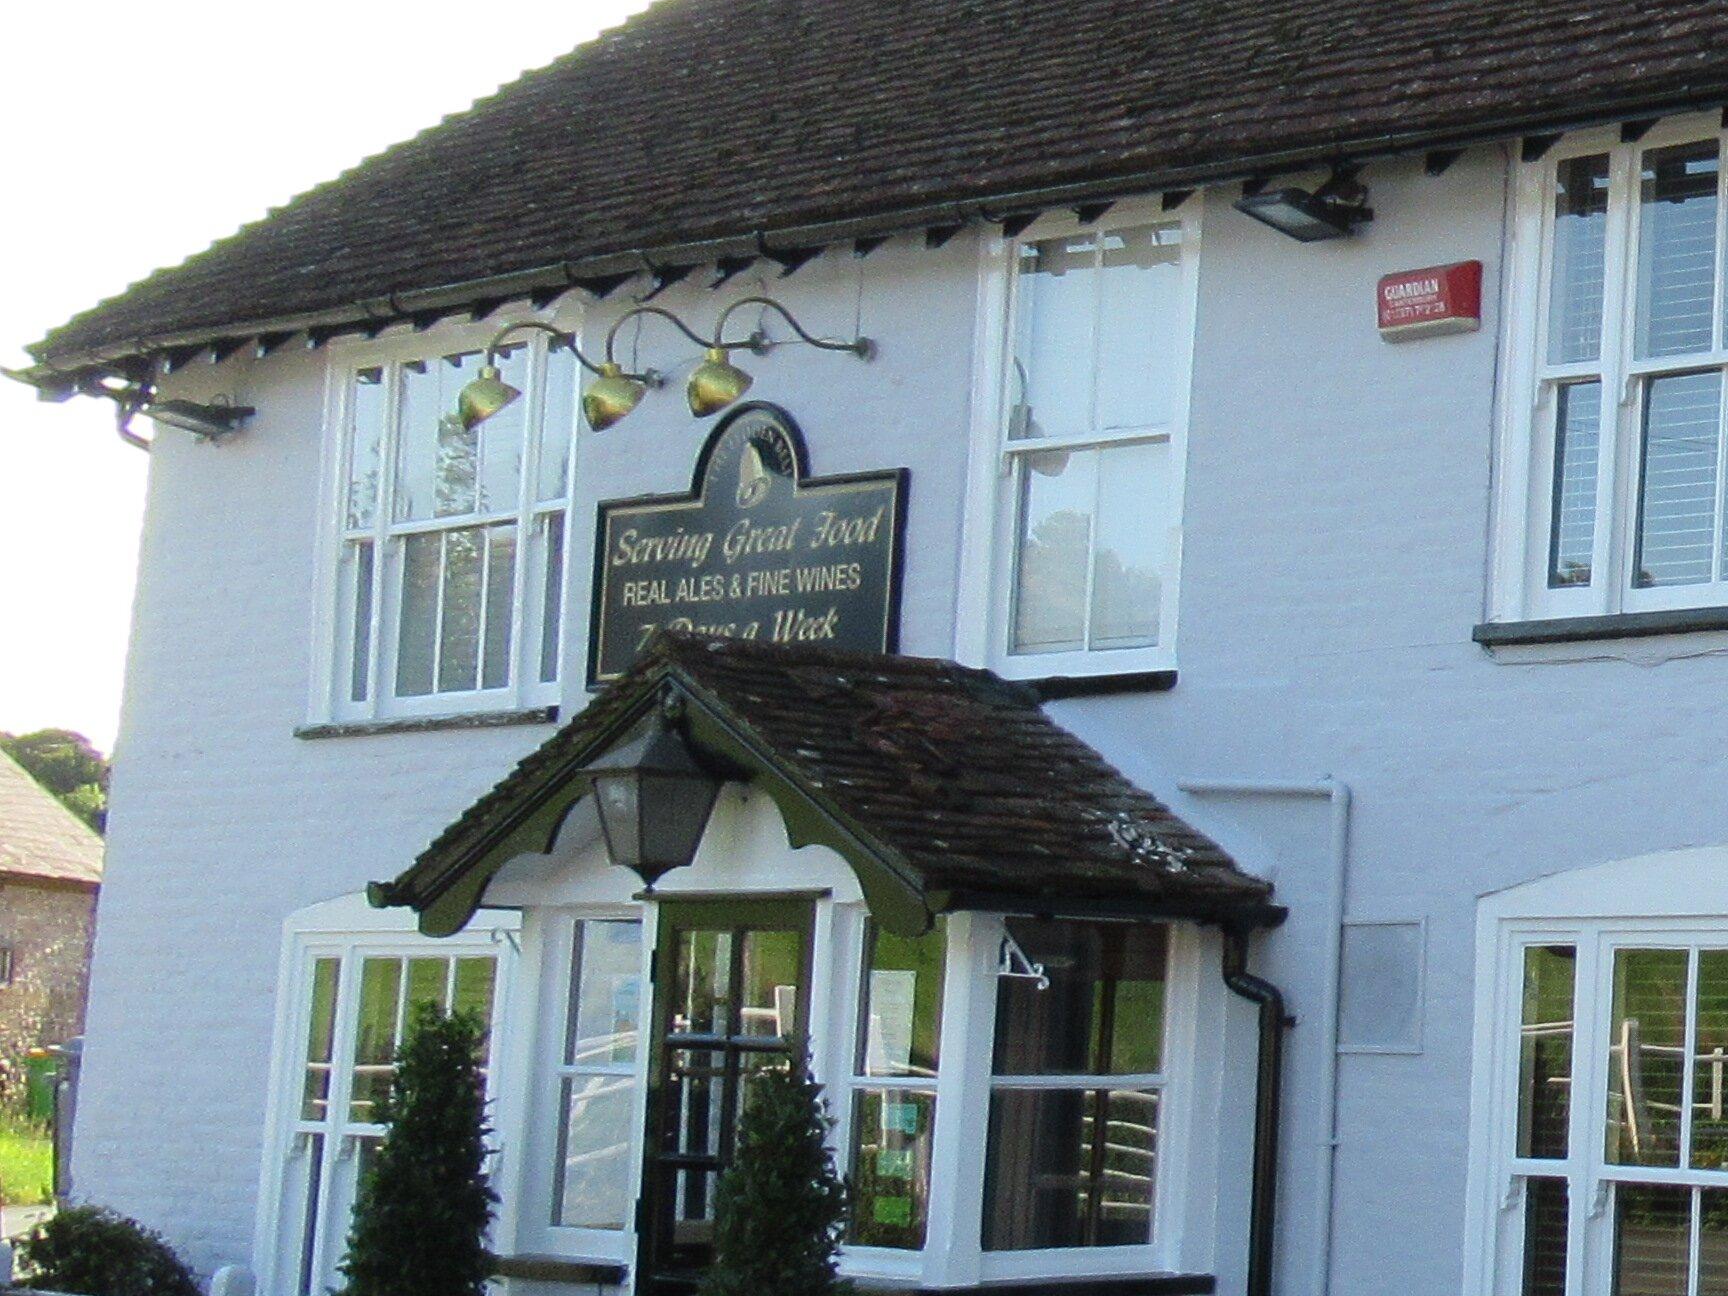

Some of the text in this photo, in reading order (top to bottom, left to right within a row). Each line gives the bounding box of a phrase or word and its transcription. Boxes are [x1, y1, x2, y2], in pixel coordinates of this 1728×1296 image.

[1384, 278, 1438, 300] GUARDIAN
[612, 505, 886, 568] Serving Great Food
[623, 562, 862, 607] REAL ALES & FINE WINES
[635, 622, 657, 652] 7
[771, 606, 840, 643] Week
